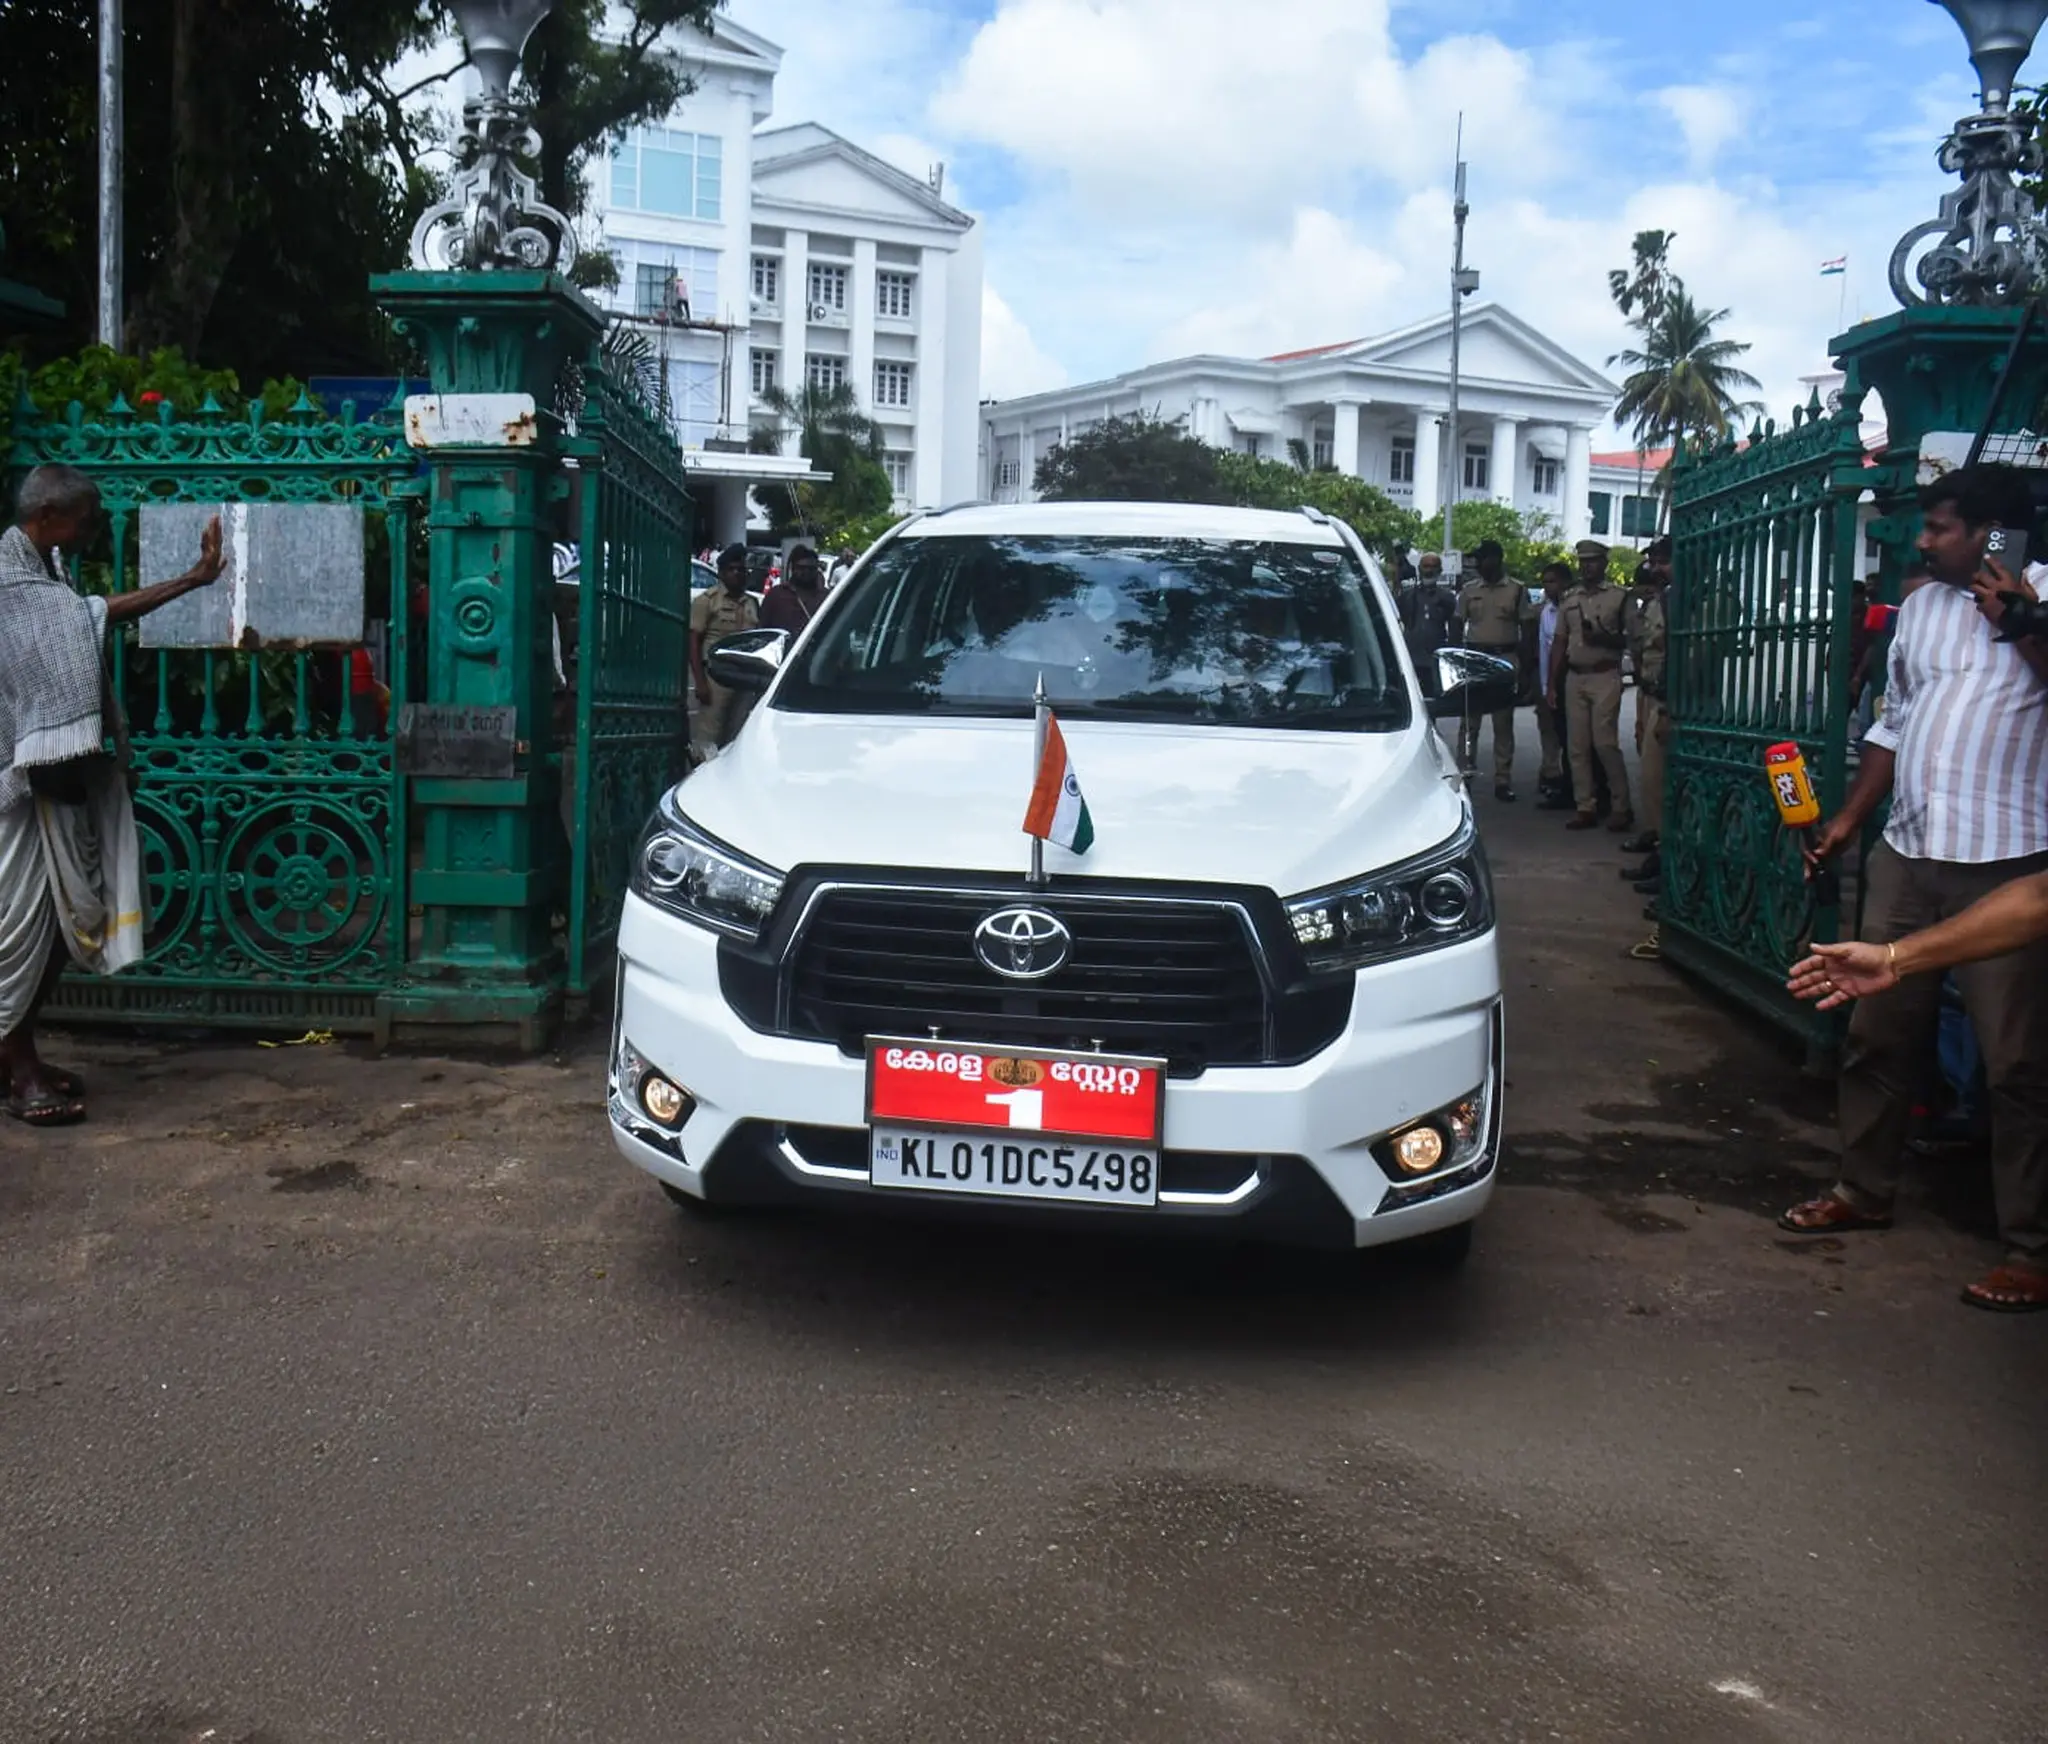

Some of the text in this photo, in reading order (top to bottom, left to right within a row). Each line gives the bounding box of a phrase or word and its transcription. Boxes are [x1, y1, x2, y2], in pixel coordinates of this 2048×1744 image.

[886, 1048, 983, 1081] കേരള
[985, 1089, 1043, 1130] 1
[876, 1149, 898, 1162] IND
[901, 1137, 1151, 1194] KL01DC5498
